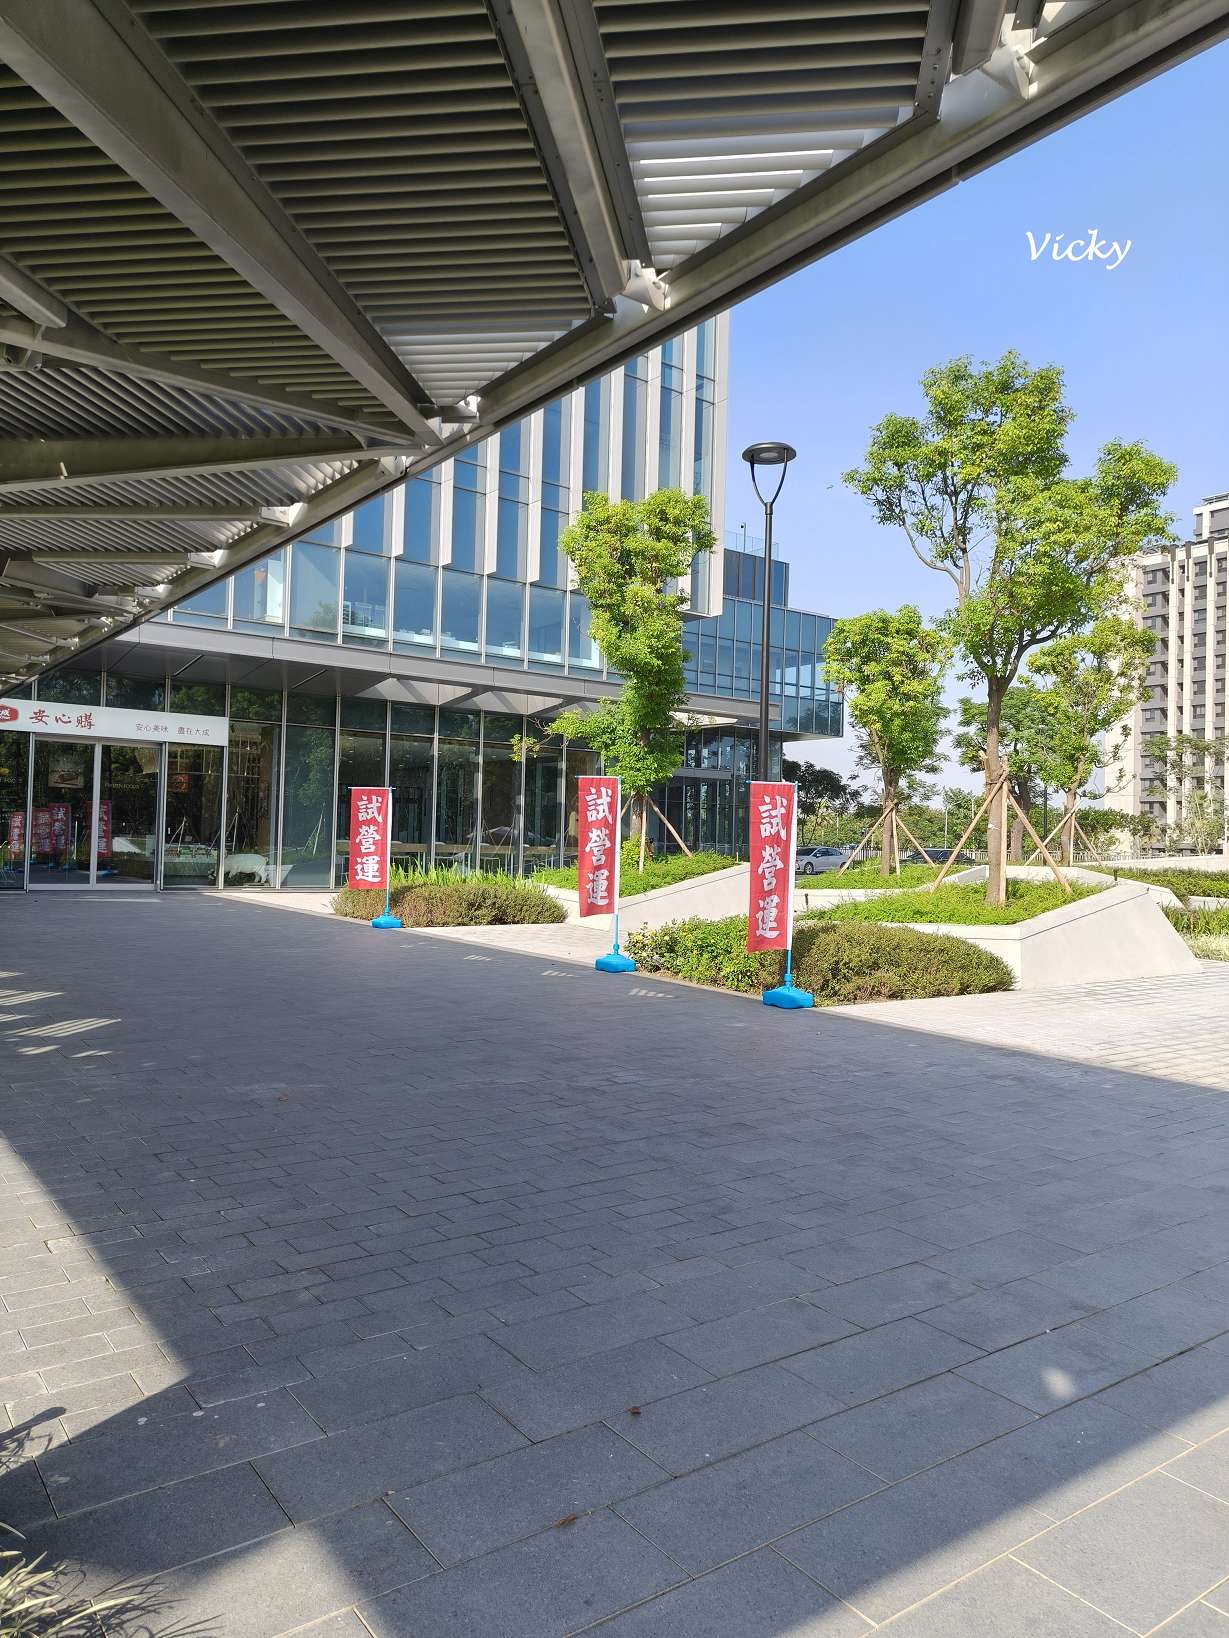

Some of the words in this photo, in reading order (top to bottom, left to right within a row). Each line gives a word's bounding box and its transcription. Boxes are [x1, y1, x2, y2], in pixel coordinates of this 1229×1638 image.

[29, 709, 95, 729] 安心購
[355, 795, 383, 882] 試營運
[585, 786, 613, 906] 試營運
[756, 795, 787, 939] 試營運
